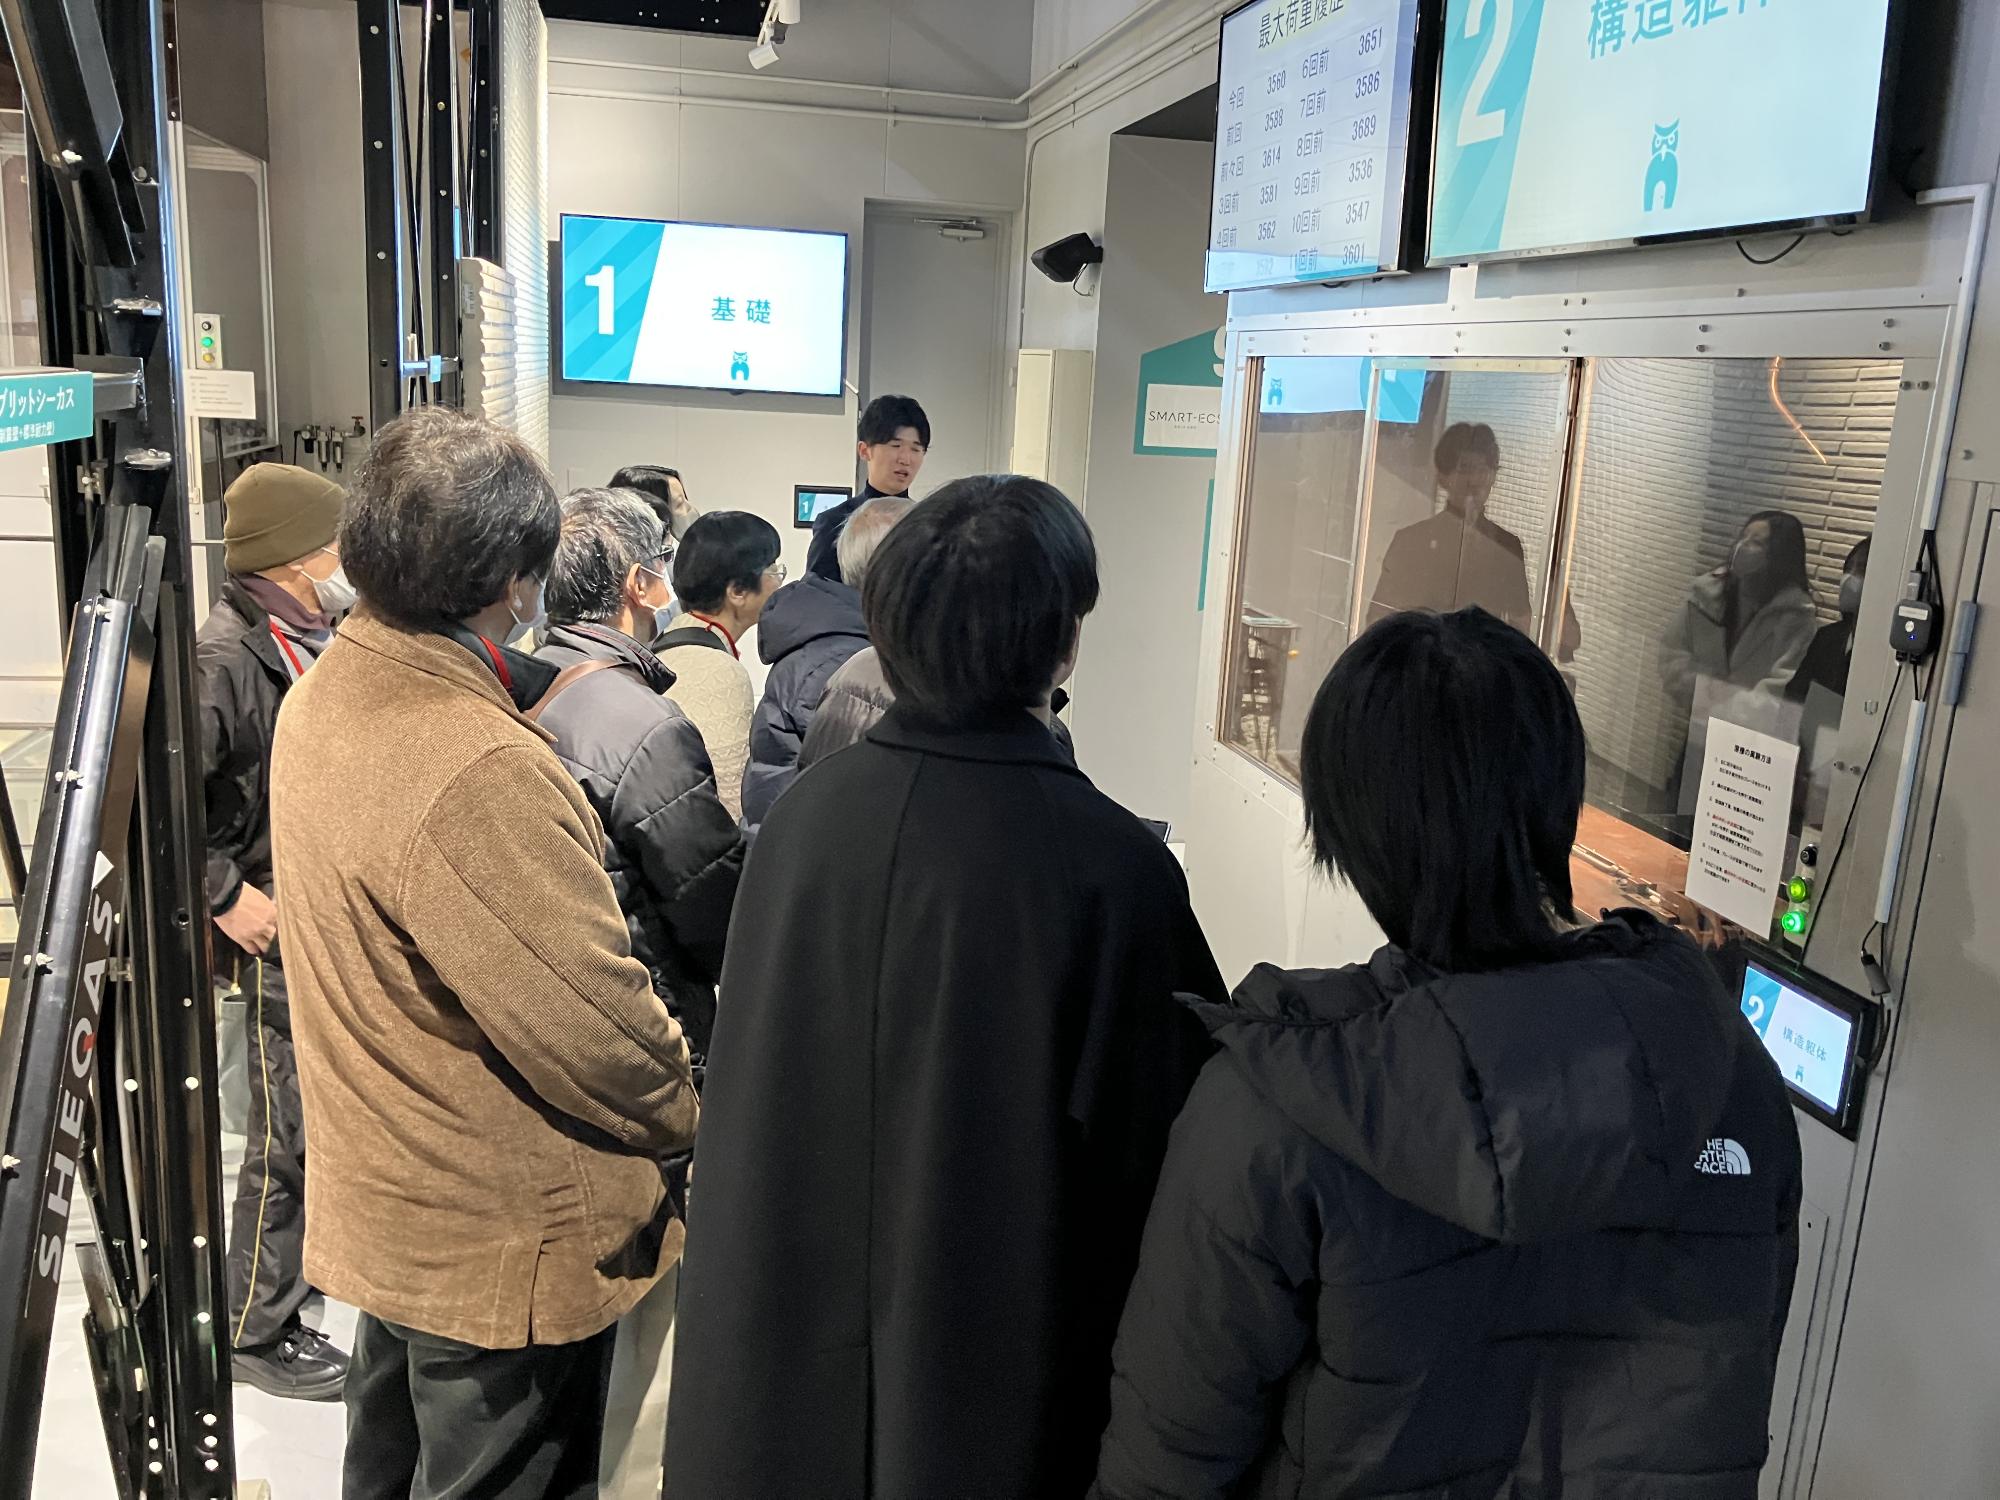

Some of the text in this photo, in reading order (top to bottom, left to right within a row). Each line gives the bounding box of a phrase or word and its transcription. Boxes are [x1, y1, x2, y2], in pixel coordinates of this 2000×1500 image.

[1588, 0, 1768, 60] 構造
[1302, 26, 1383, 79] 6回前 3651
[1229, 70, 1286, 111] 今回 3560
[1457, 0, 1514, 147] 2
[1300, 71, 1380, 118] 7回前 3586
[1265, 108, 1284, 132] 3588
[1296, 114, 1376, 157] 8回前 3689
[1262, 145, 1281, 168] 3614
[1294, 158, 1373, 196] 9回前 3536
[1218, 183, 1278, 215] 3回前 3581
[1217, 220, 1276, 248] 4回前 3562
[1292, 201, 1370, 234] 10回前 3547
[1342, 243, 1365, 267] 3601
[584, 265, 615, 336] 1
[711, 296, 772, 325] 基礎
[802, 501, 809, 513] 1
[1748, 995, 1766, 1037] 2
[39, 892, 113, 1283] SHEQAS
[1699, 1150, 1725, 1163] RTH
[1706, 1138, 1724, 1151] HE
